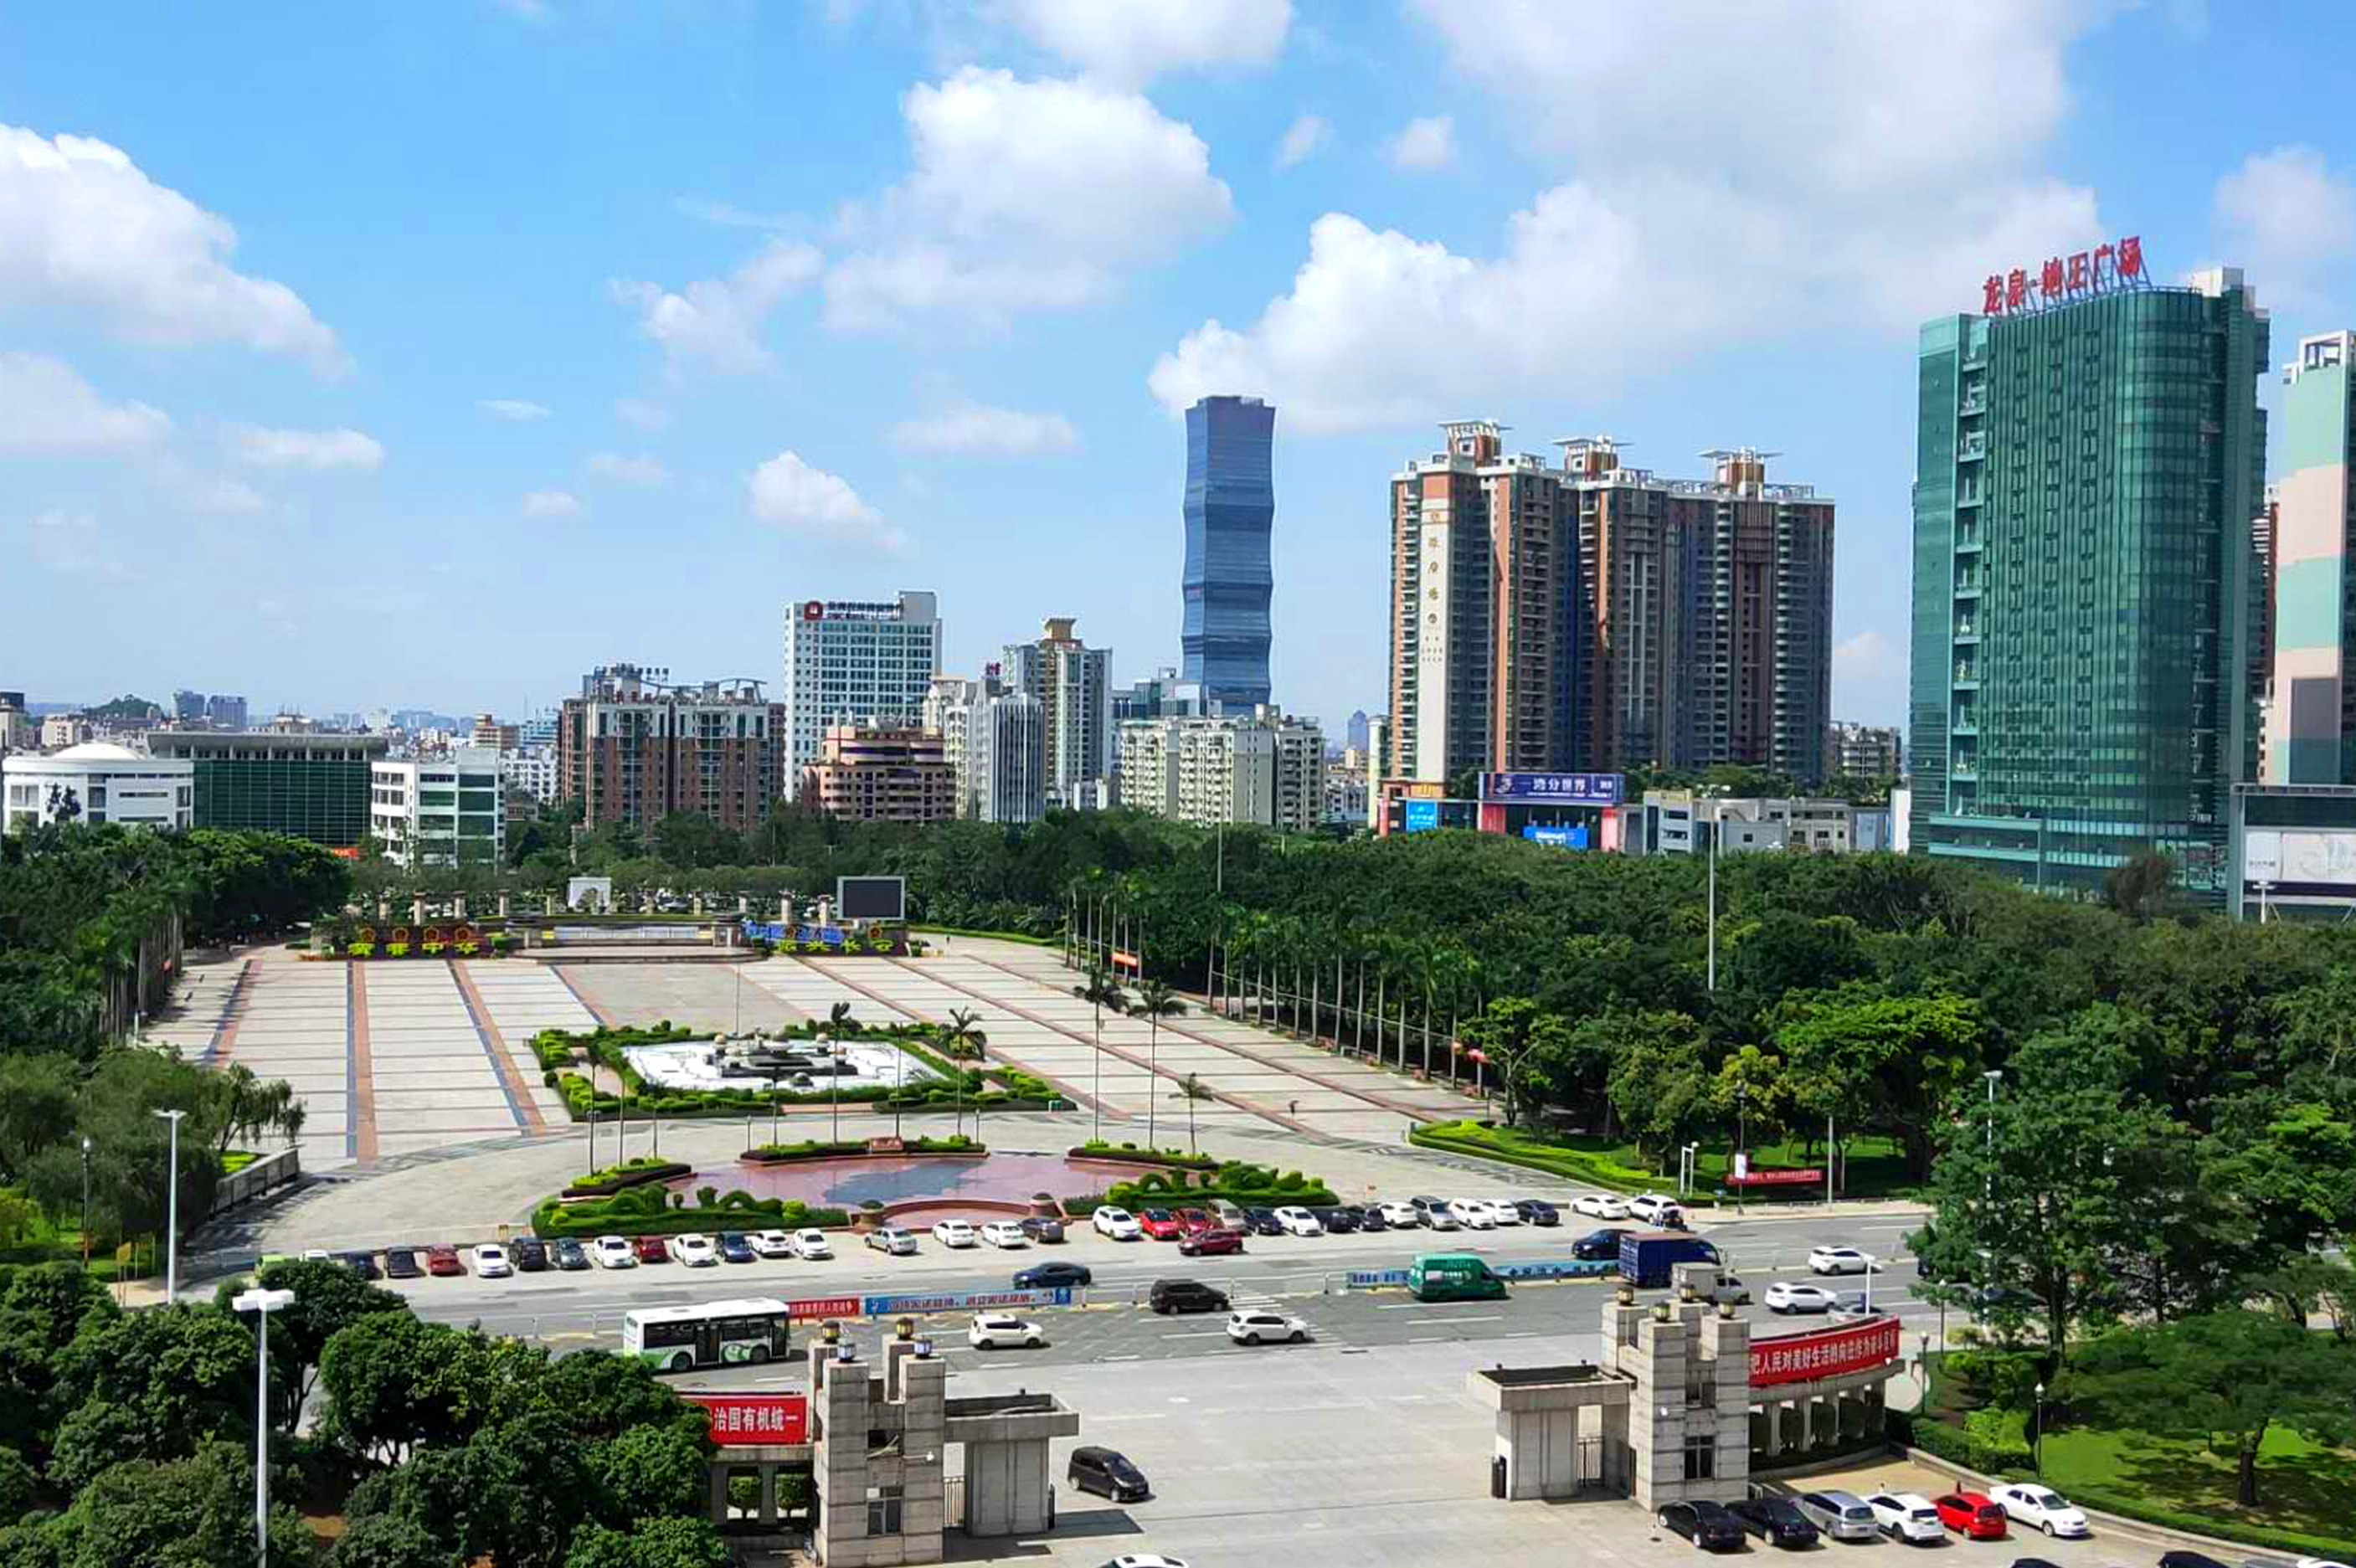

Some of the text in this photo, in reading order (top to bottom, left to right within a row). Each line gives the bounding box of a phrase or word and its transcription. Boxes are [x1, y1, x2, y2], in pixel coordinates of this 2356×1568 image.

[714, 1406, 799, 1432] 治国有机统一
